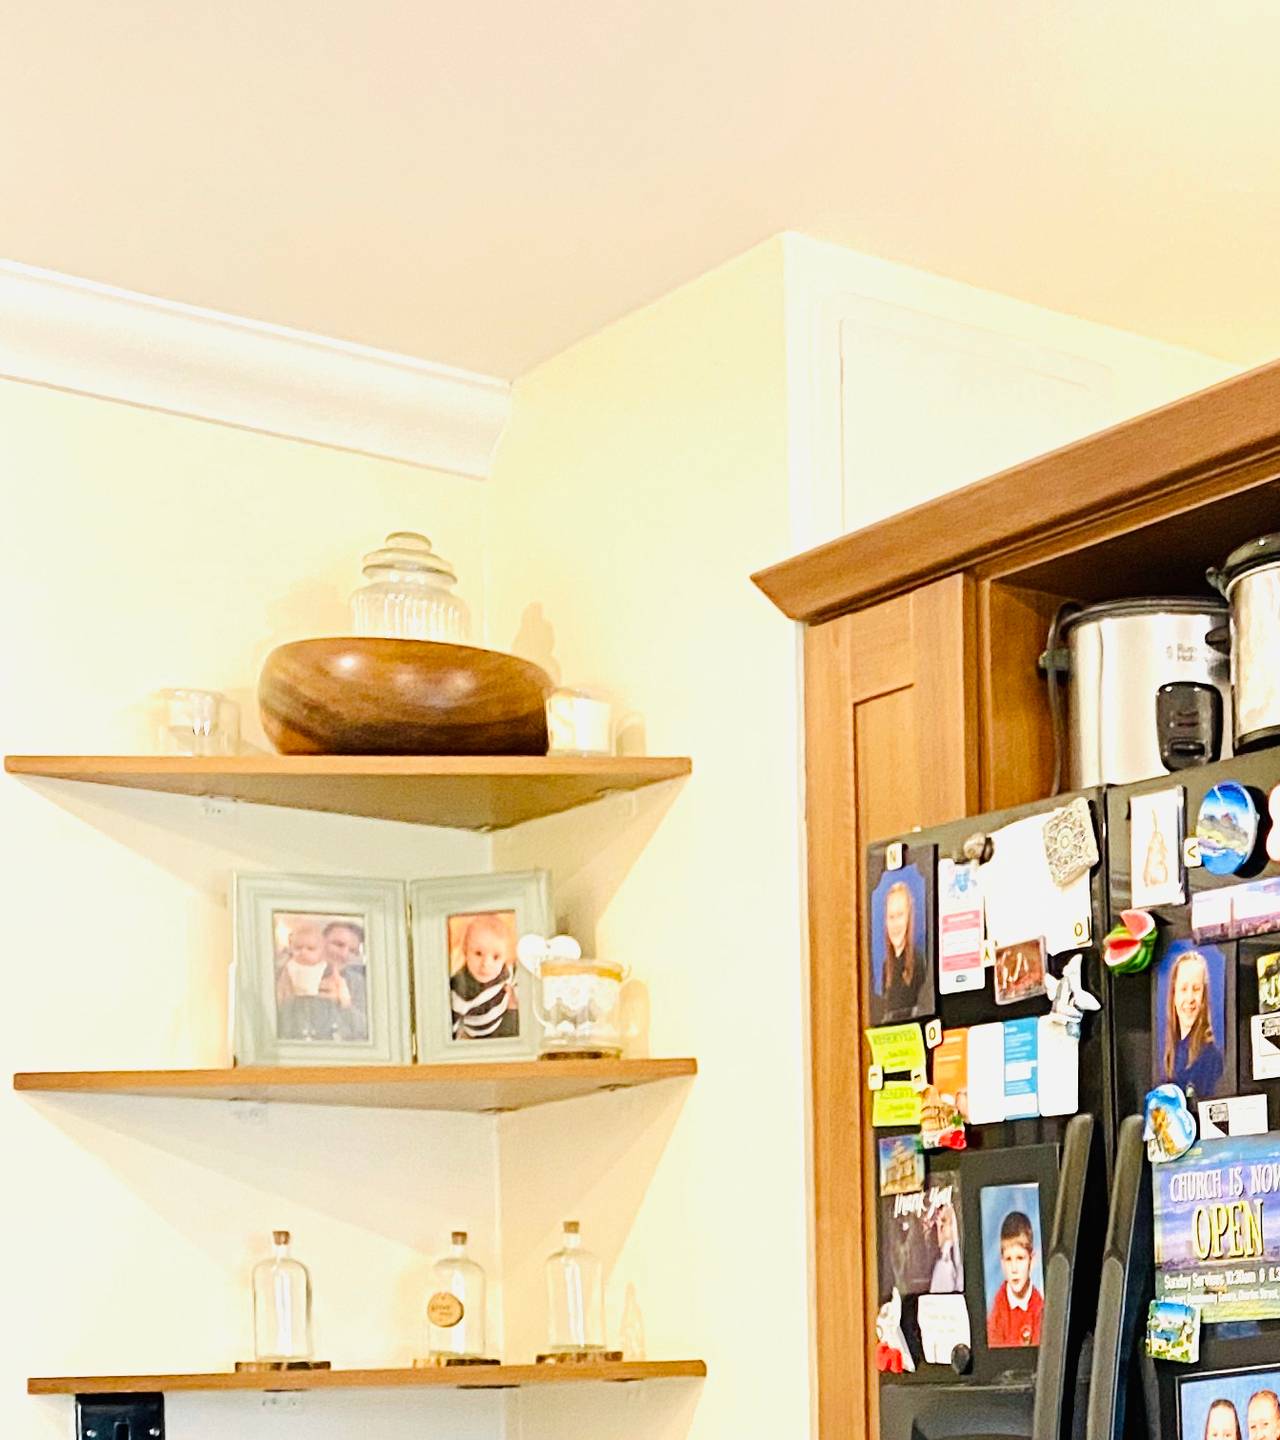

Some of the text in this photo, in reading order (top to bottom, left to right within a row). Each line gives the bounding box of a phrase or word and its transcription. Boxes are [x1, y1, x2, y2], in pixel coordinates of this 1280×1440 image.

[1170, 1168, 1223, 1203] CHURCH
[1229, 1166, 1244, 1198] IS
[1192, 1198, 1265, 1261] OPEN
